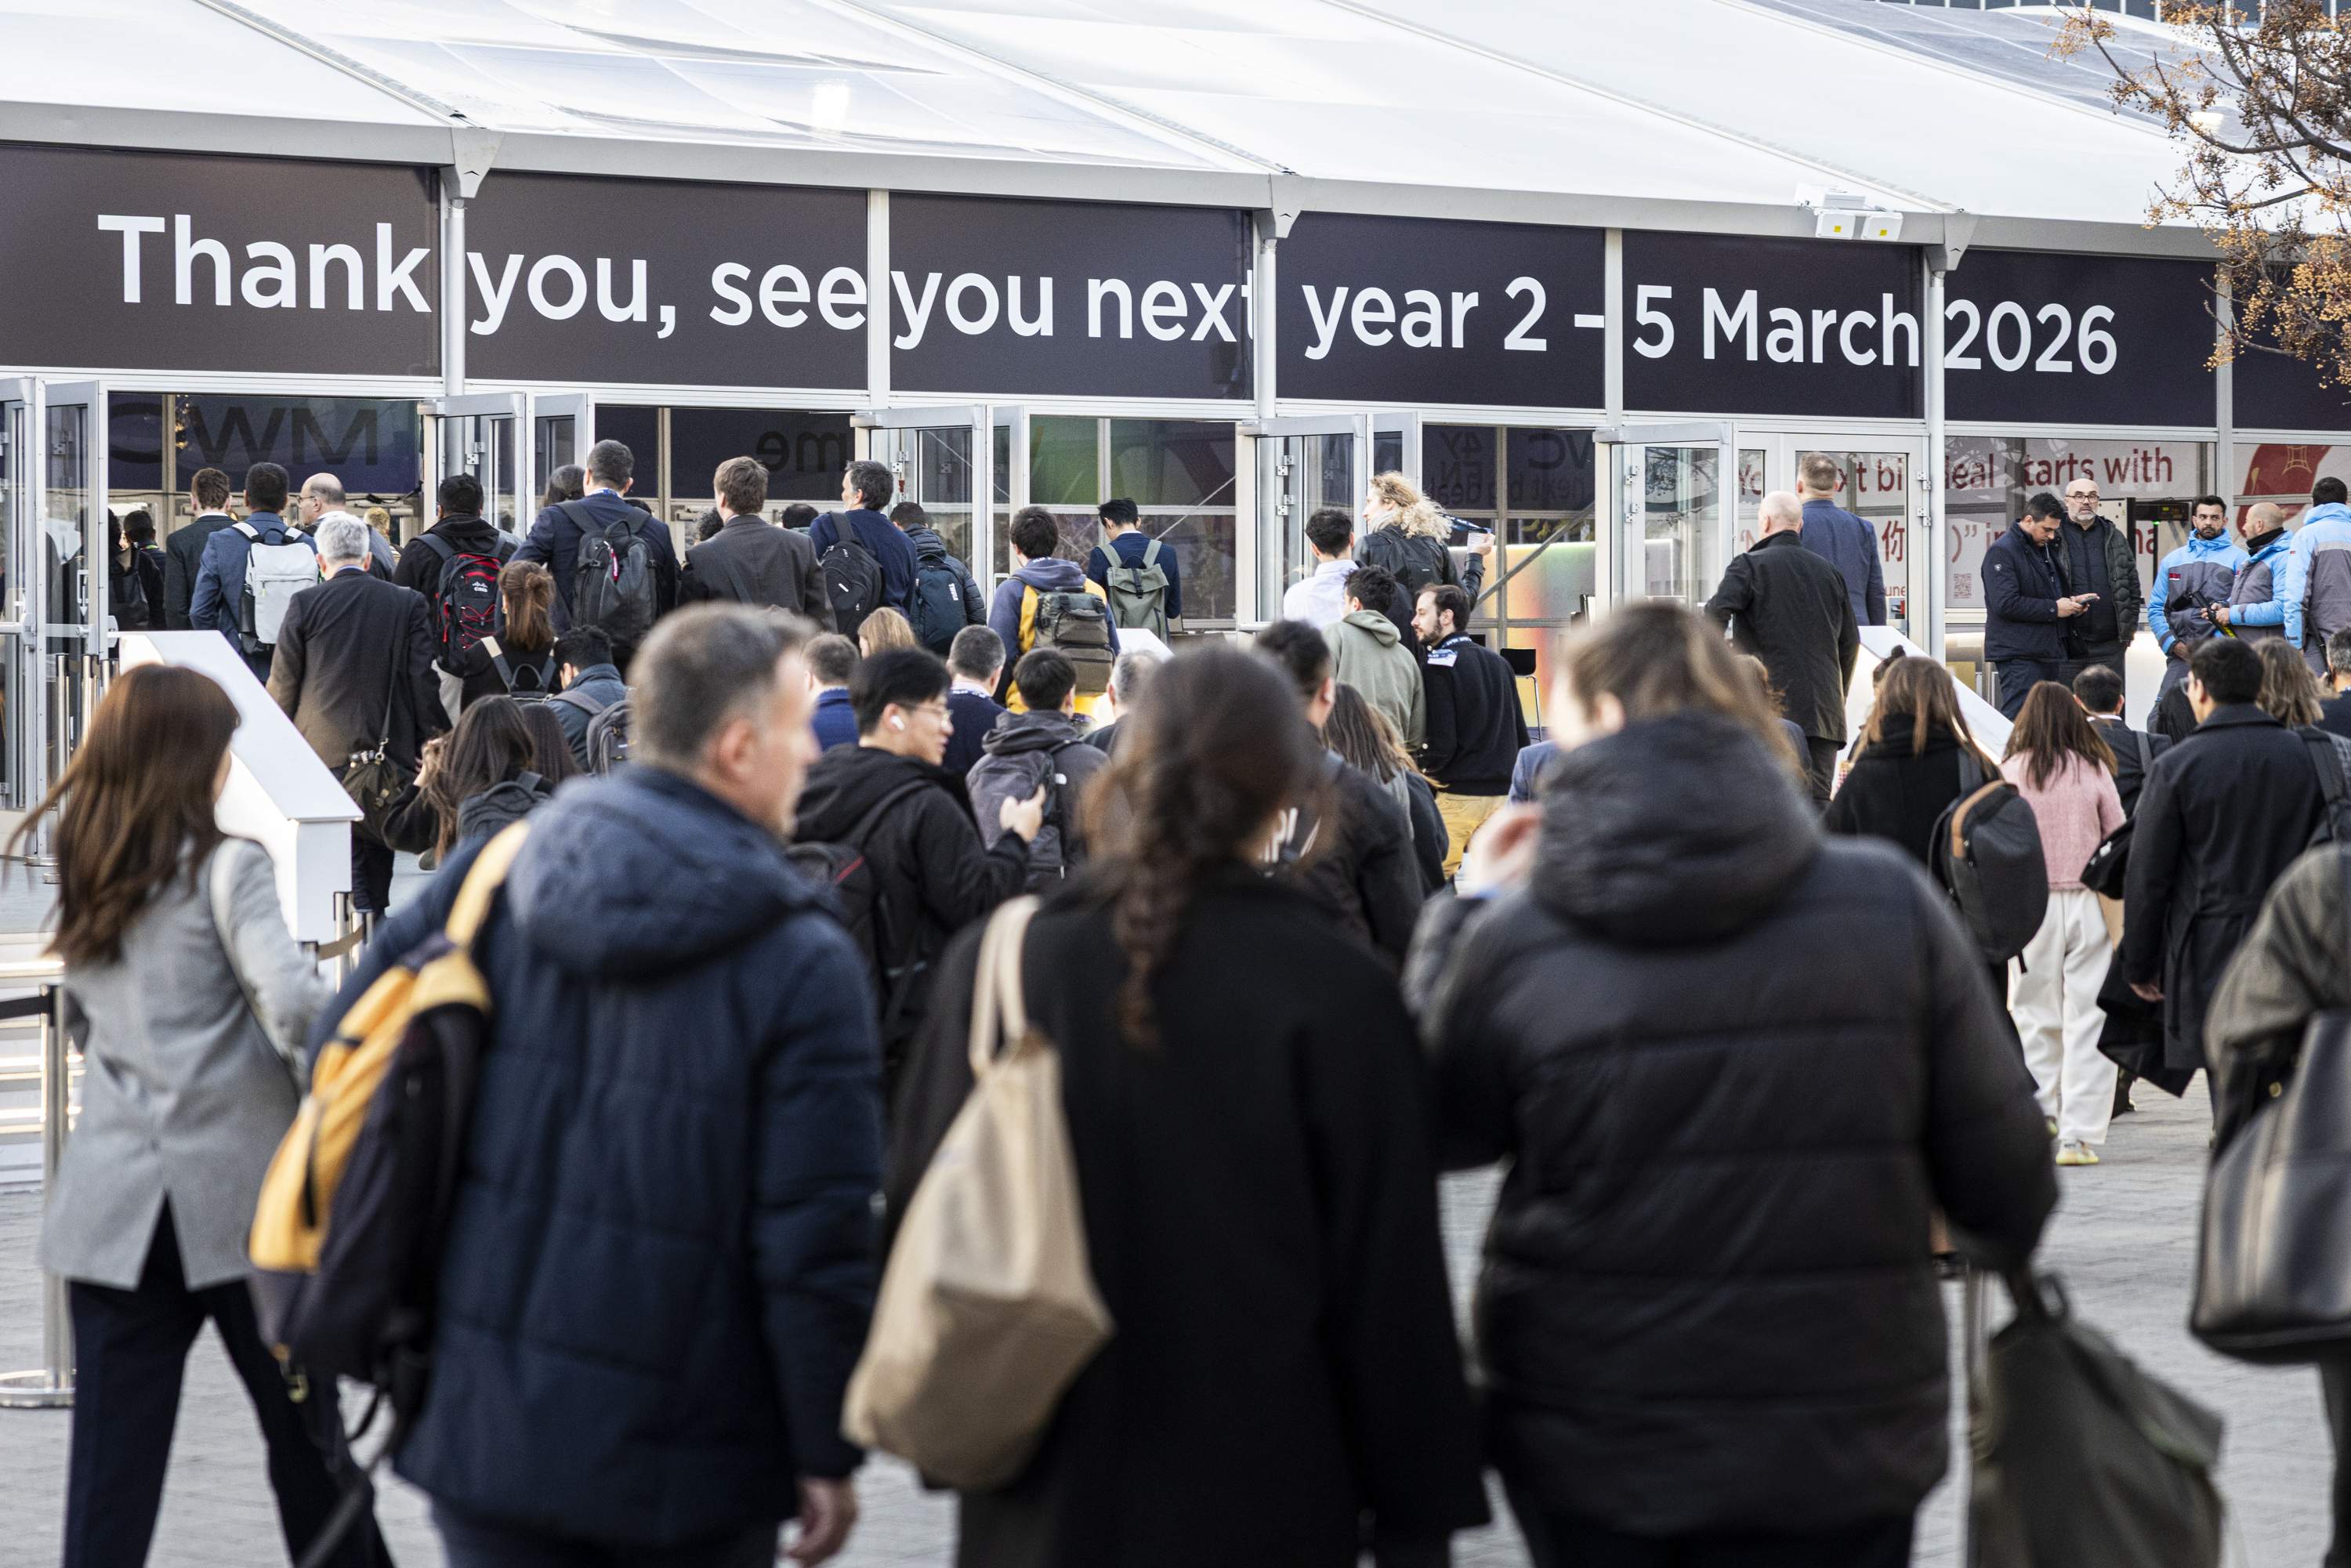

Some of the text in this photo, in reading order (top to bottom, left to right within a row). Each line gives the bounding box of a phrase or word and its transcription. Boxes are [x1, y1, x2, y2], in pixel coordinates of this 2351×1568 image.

[98, 215, 432, 312] Thank
[469, 252, 676, 339] you,
[710, 263, 867, 330] see
[891, 270, 1053, 349] you
[1087, 277, 1253, 342] next
[1302, 285, 1478, 360] year
[1505, 277, 1547, 351] 2
[1633, 284, 1675, 359] 5
[1704, 288, 1919, 369] March
[1944, 299, 2117, 375] 2026
[1878, 458, 1902, 492] bi
[2023, 452, 2093, 487] tarts
[2104, 447, 2173, 484] with
